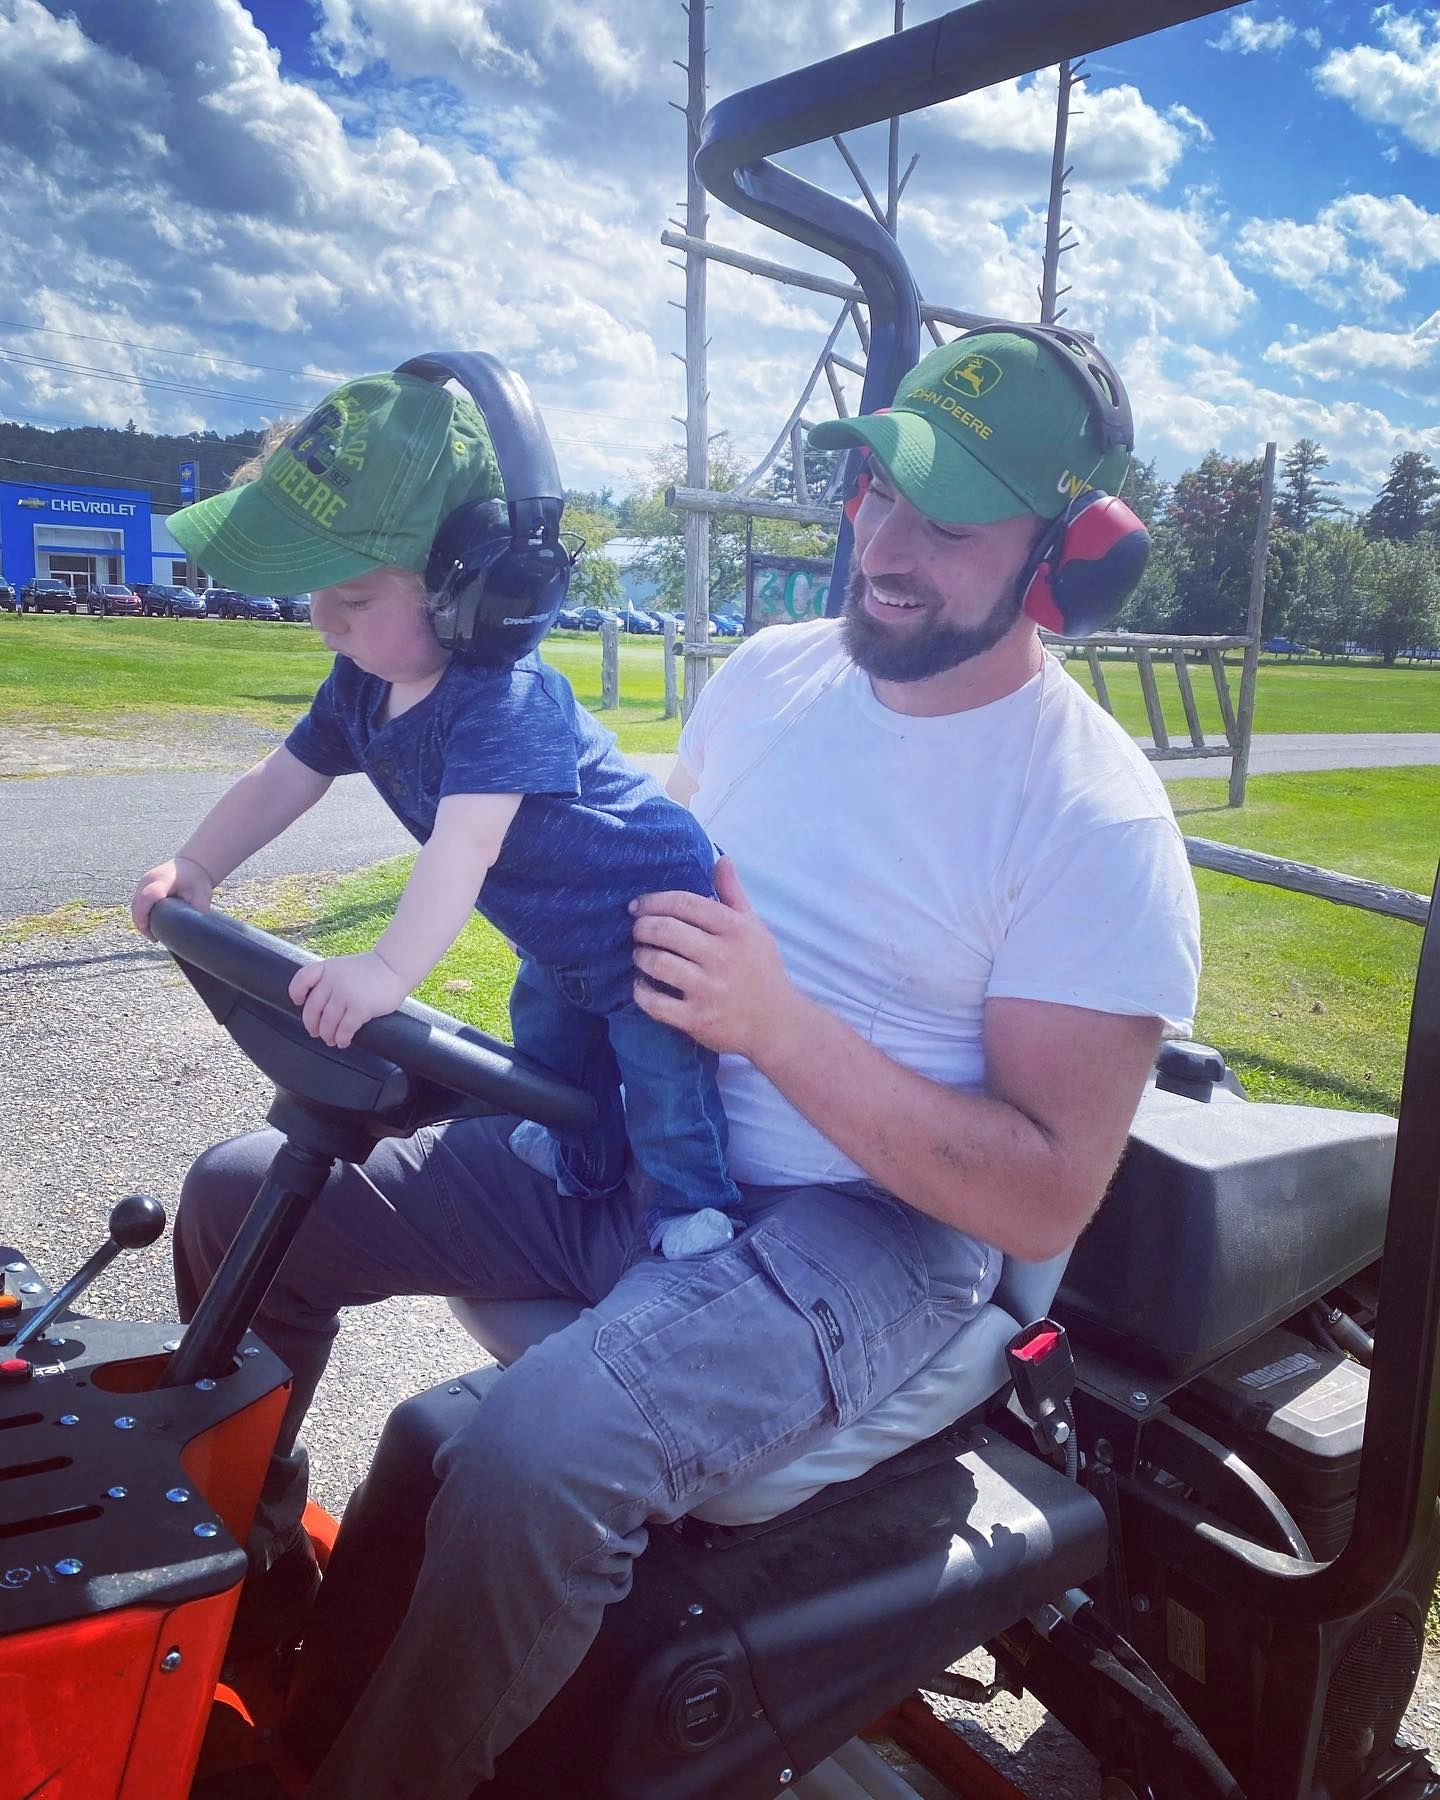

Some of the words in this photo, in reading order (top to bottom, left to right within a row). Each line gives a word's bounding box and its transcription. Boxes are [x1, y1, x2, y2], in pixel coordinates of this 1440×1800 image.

[940, 396, 993, 440] DEERE
[51, 499, 136, 516] CHEVROLET
[271, 455, 348, 528] DEERE
